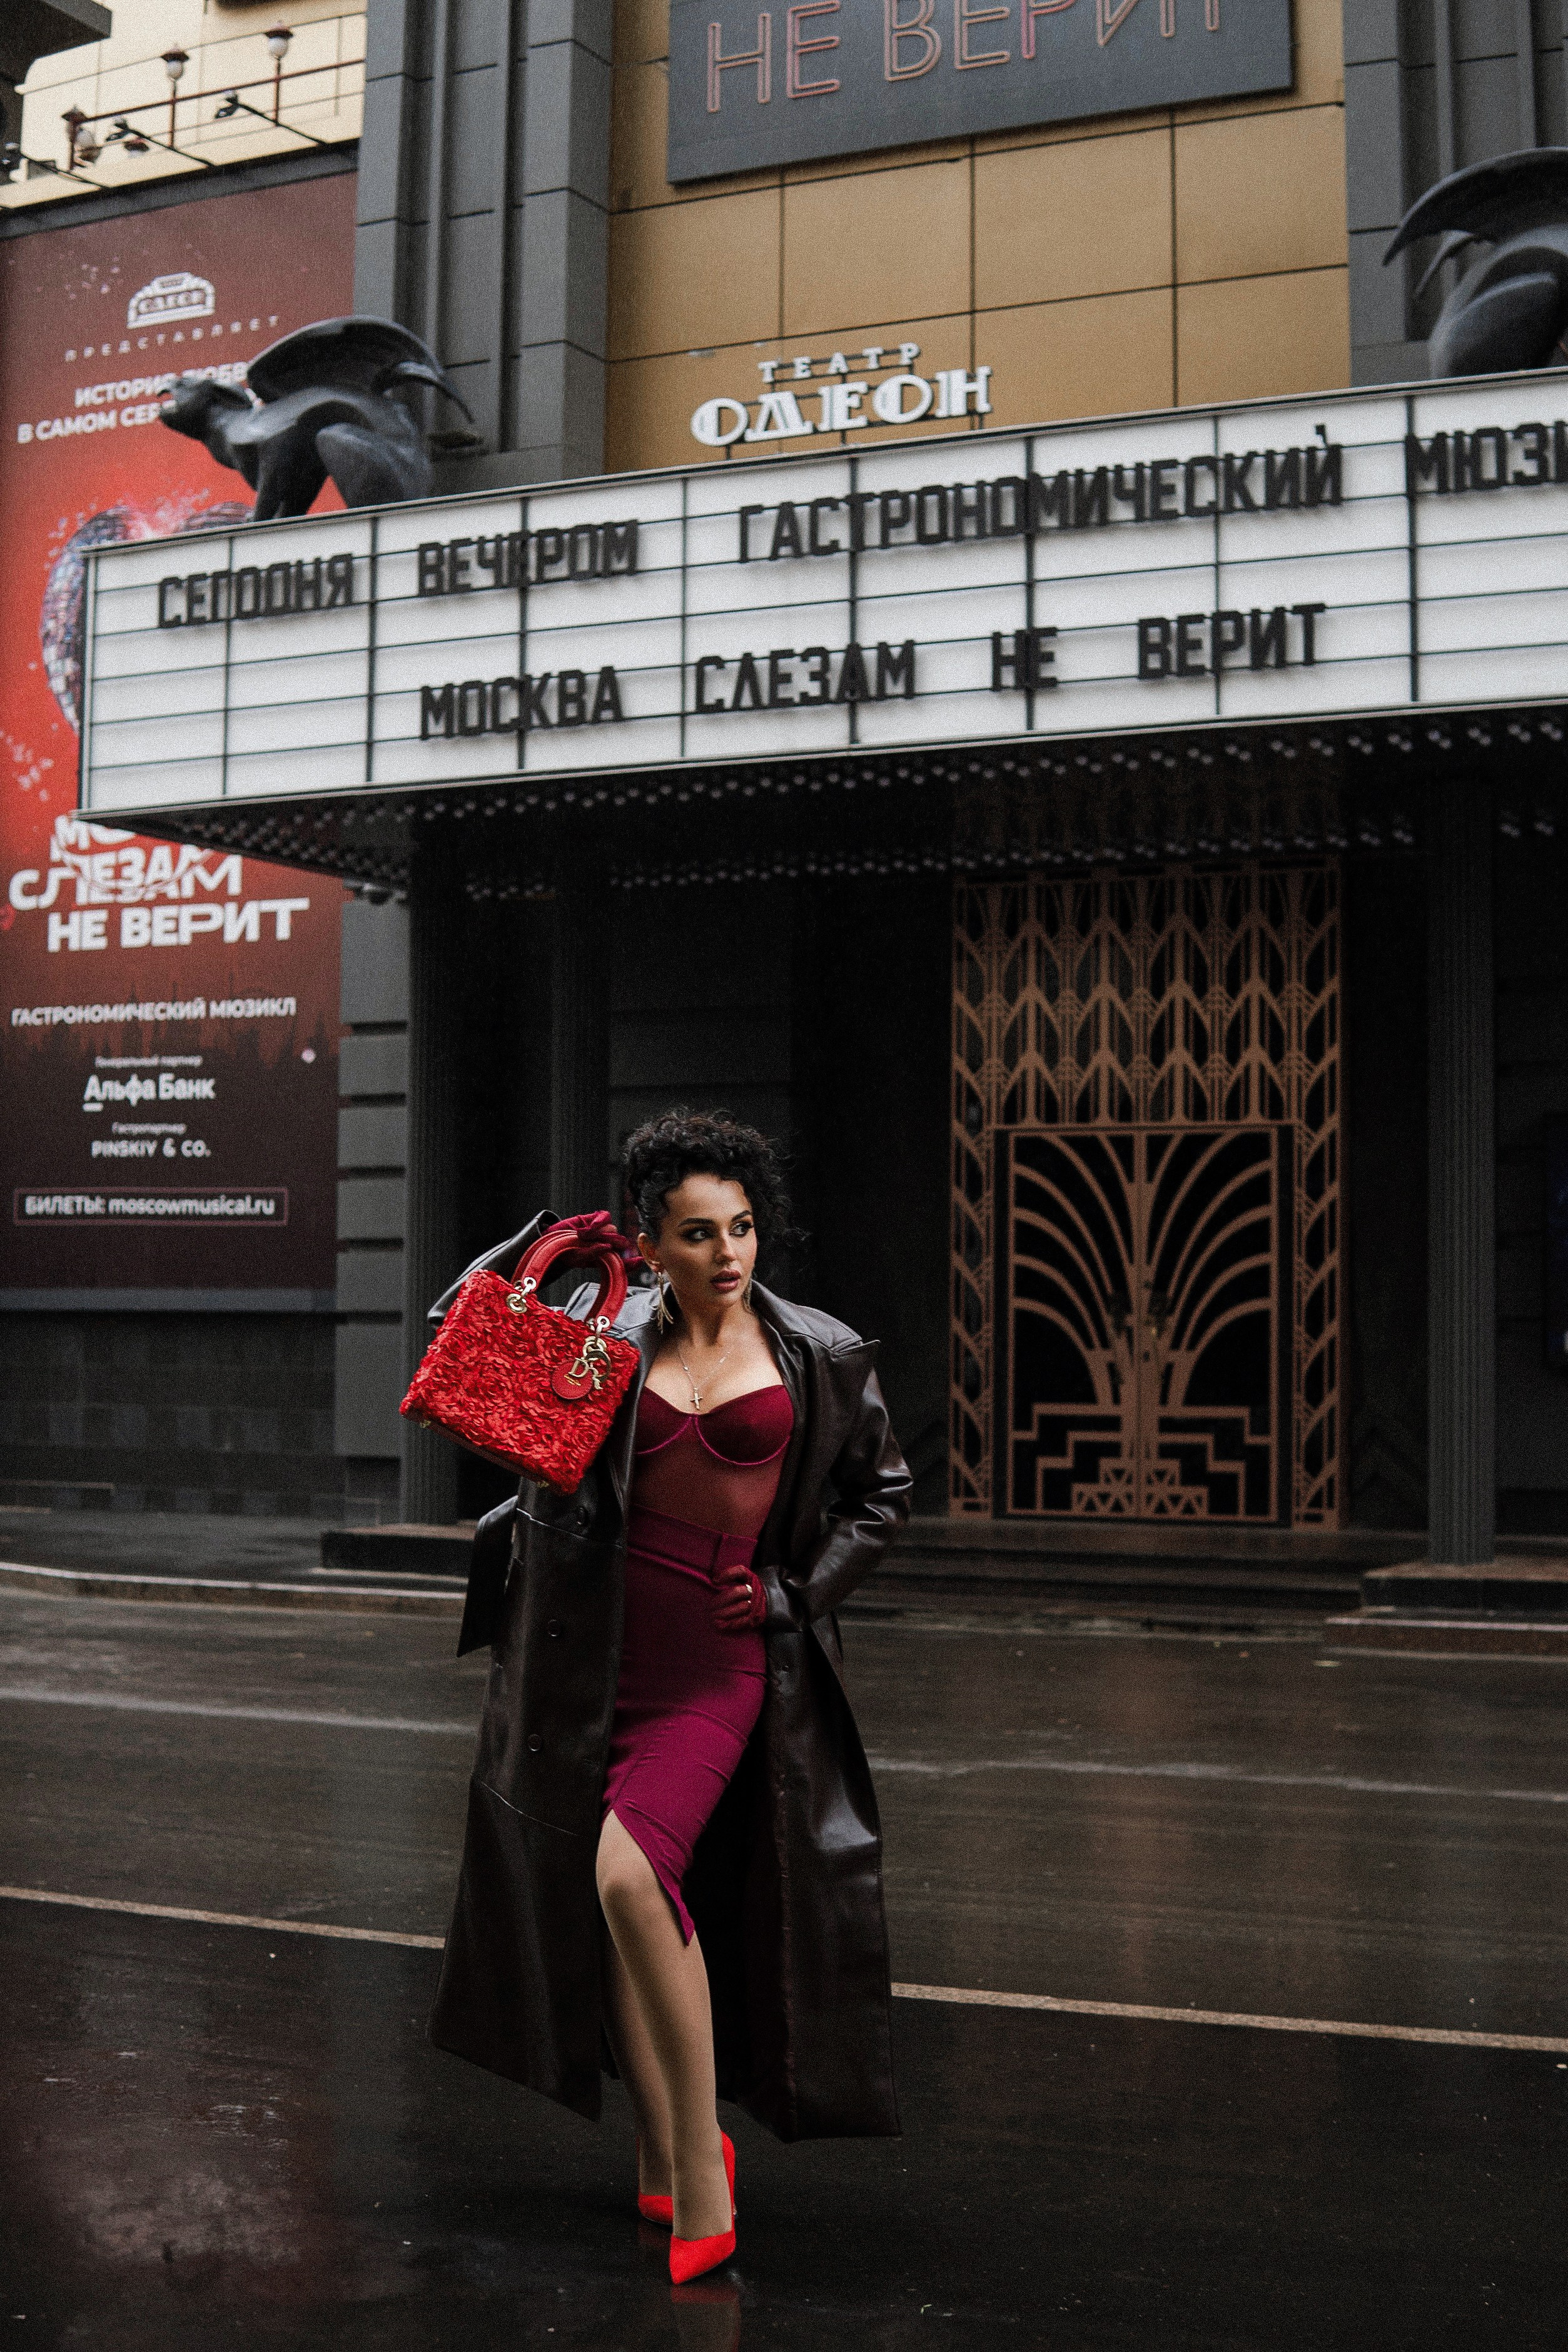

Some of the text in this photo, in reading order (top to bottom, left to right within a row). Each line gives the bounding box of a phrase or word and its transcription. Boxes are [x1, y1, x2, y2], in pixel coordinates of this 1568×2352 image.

[707, 0, 841, 113] НЕ
[757, 342, 921, 383] ТЕАТР
[17, 423, 32, 444] В
[36, 409, 117, 442] САМОМ
[690, 365, 993, 447] ОДЕОН
[158, 553, 354, 627] СЕГОДНЯ
[417, 519, 639, 597] ВЕЧЕРОМ
[739, 423, 1343, 563] ГАСТРОНОМИЧЕСКИЙ
[419, 602, 1327, 741] МОСКВА СЛЕЗАМ НЕ ВЕРИТ
[47, 896, 310, 953] НЕ ВЕРИТ
[11, 997, 297, 1026] ГАСТРОНОМИЧЕСКИЙ МЮЗИКЛ
[82, 1073, 216, 1112] Альфа Банк
[181, 1139, 212, 1158] CO.
[109, 1194, 276, 1217] moscowmusical.ru
